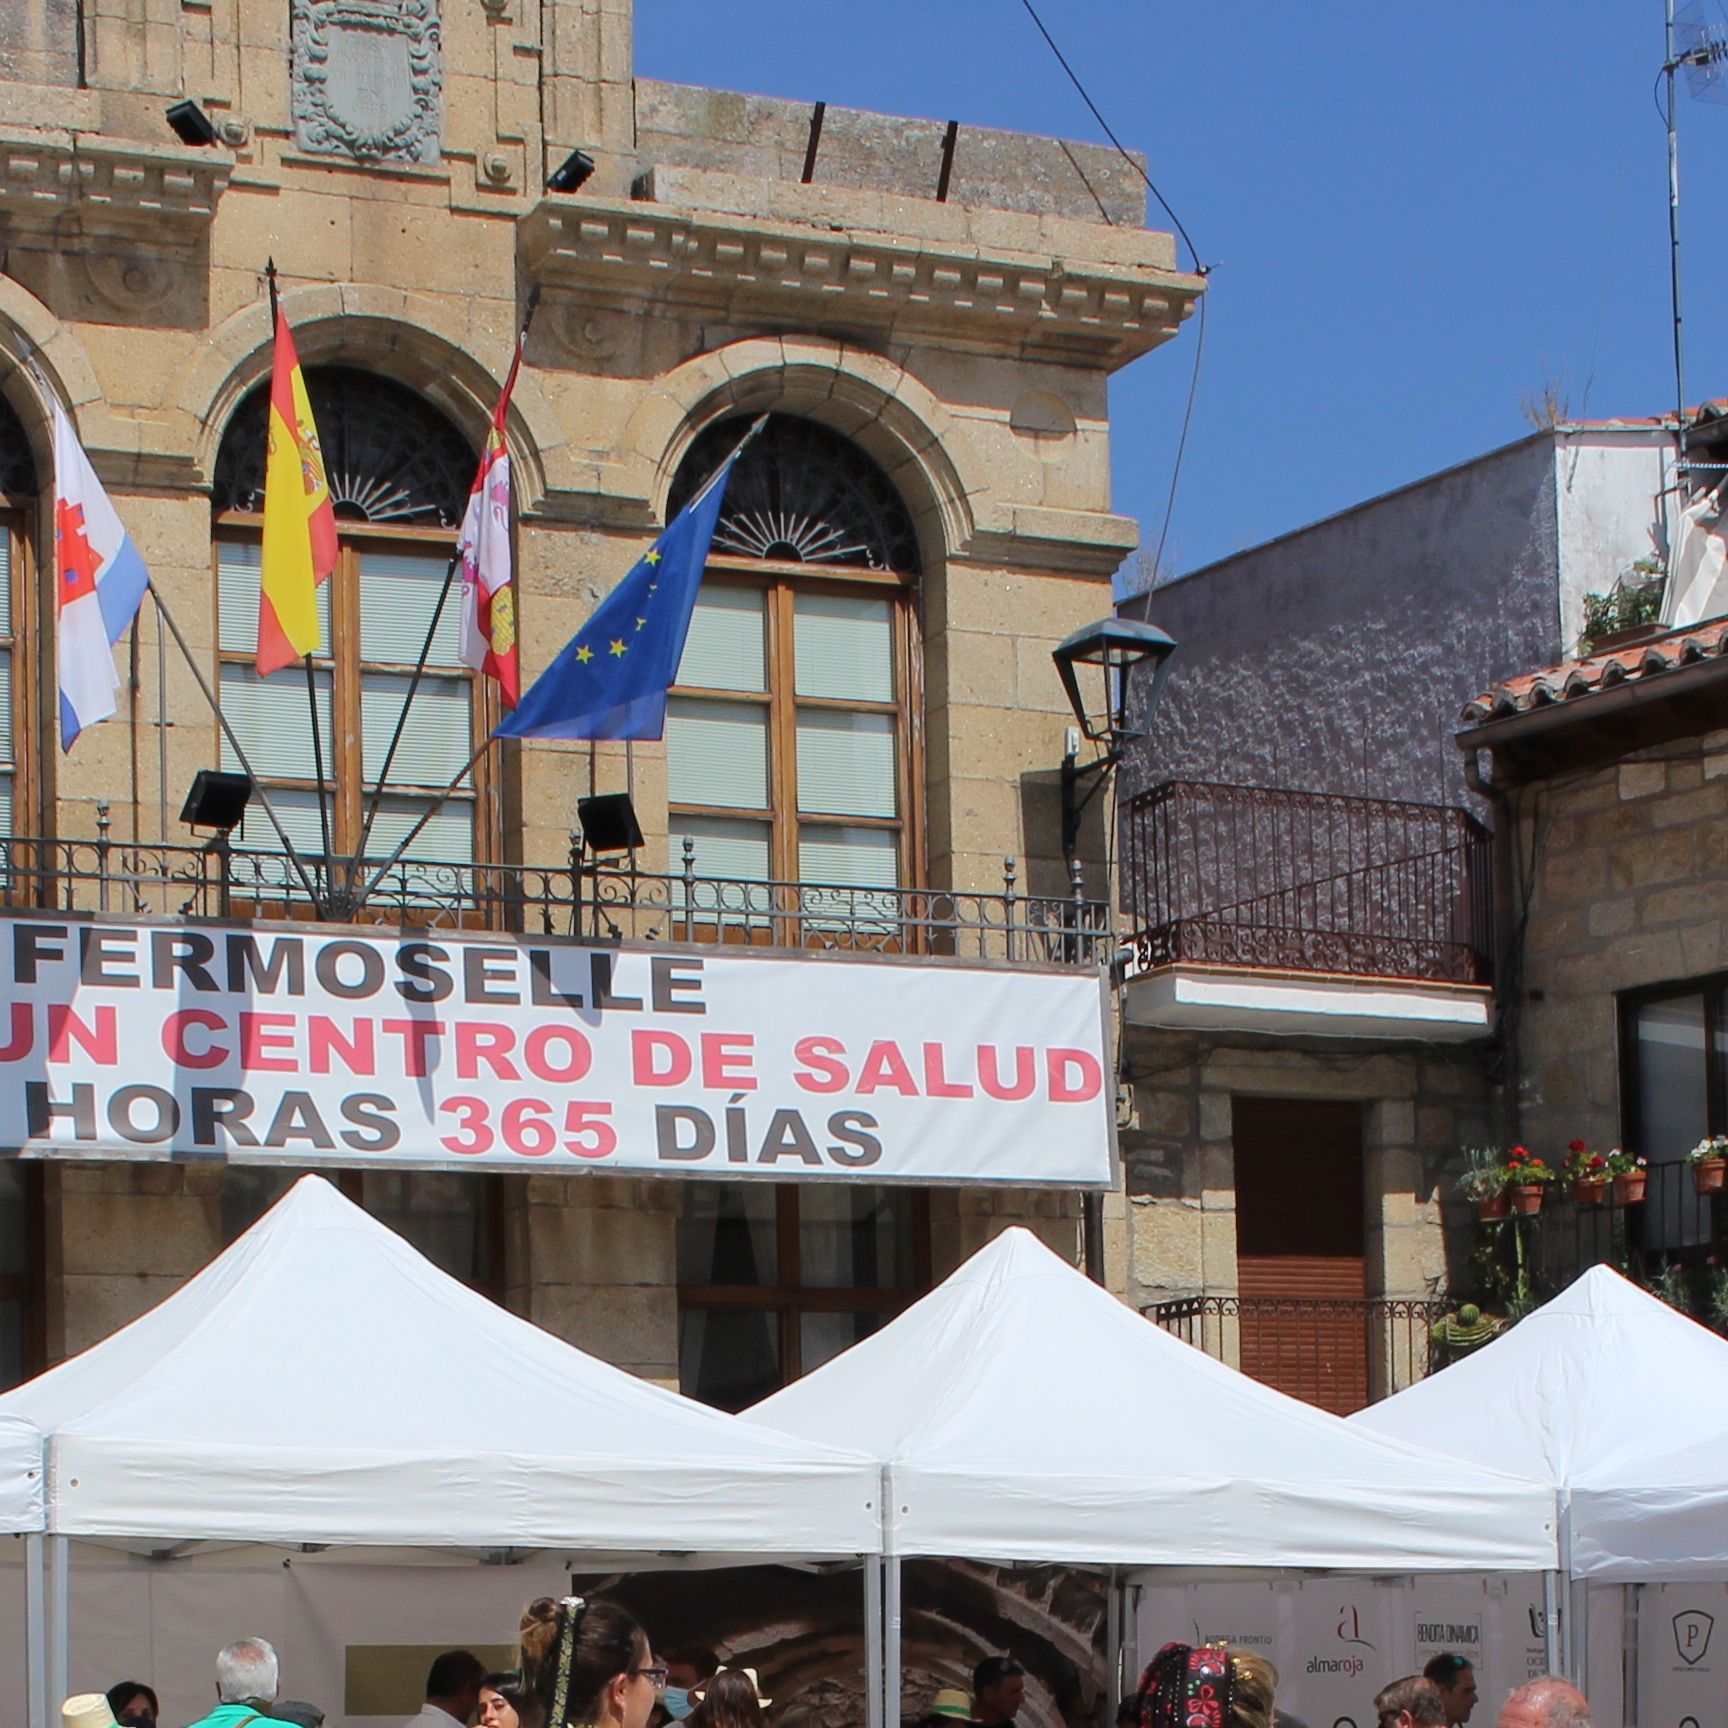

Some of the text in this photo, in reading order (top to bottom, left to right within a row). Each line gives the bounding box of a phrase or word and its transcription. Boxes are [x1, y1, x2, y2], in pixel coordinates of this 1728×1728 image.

[13, 924, 707, 1015] FERMOSELLE
[161, 1008, 593, 1083] CENTRO
[630, 1028, 759, 1091] DE
[792, 1035, 1103, 1102] SALUD
[25, 1081, 402, 1152] HORAS
[438, 1096, 618, 1158] 365
[654, 1093, 883, 1168] DÍAS
[1204, 1634, 1272, 1645] BODEGA FRONTIO
[1685, 1624, 1699, 1648] P
[1306, 1656, 1364, 1677] almaroja
